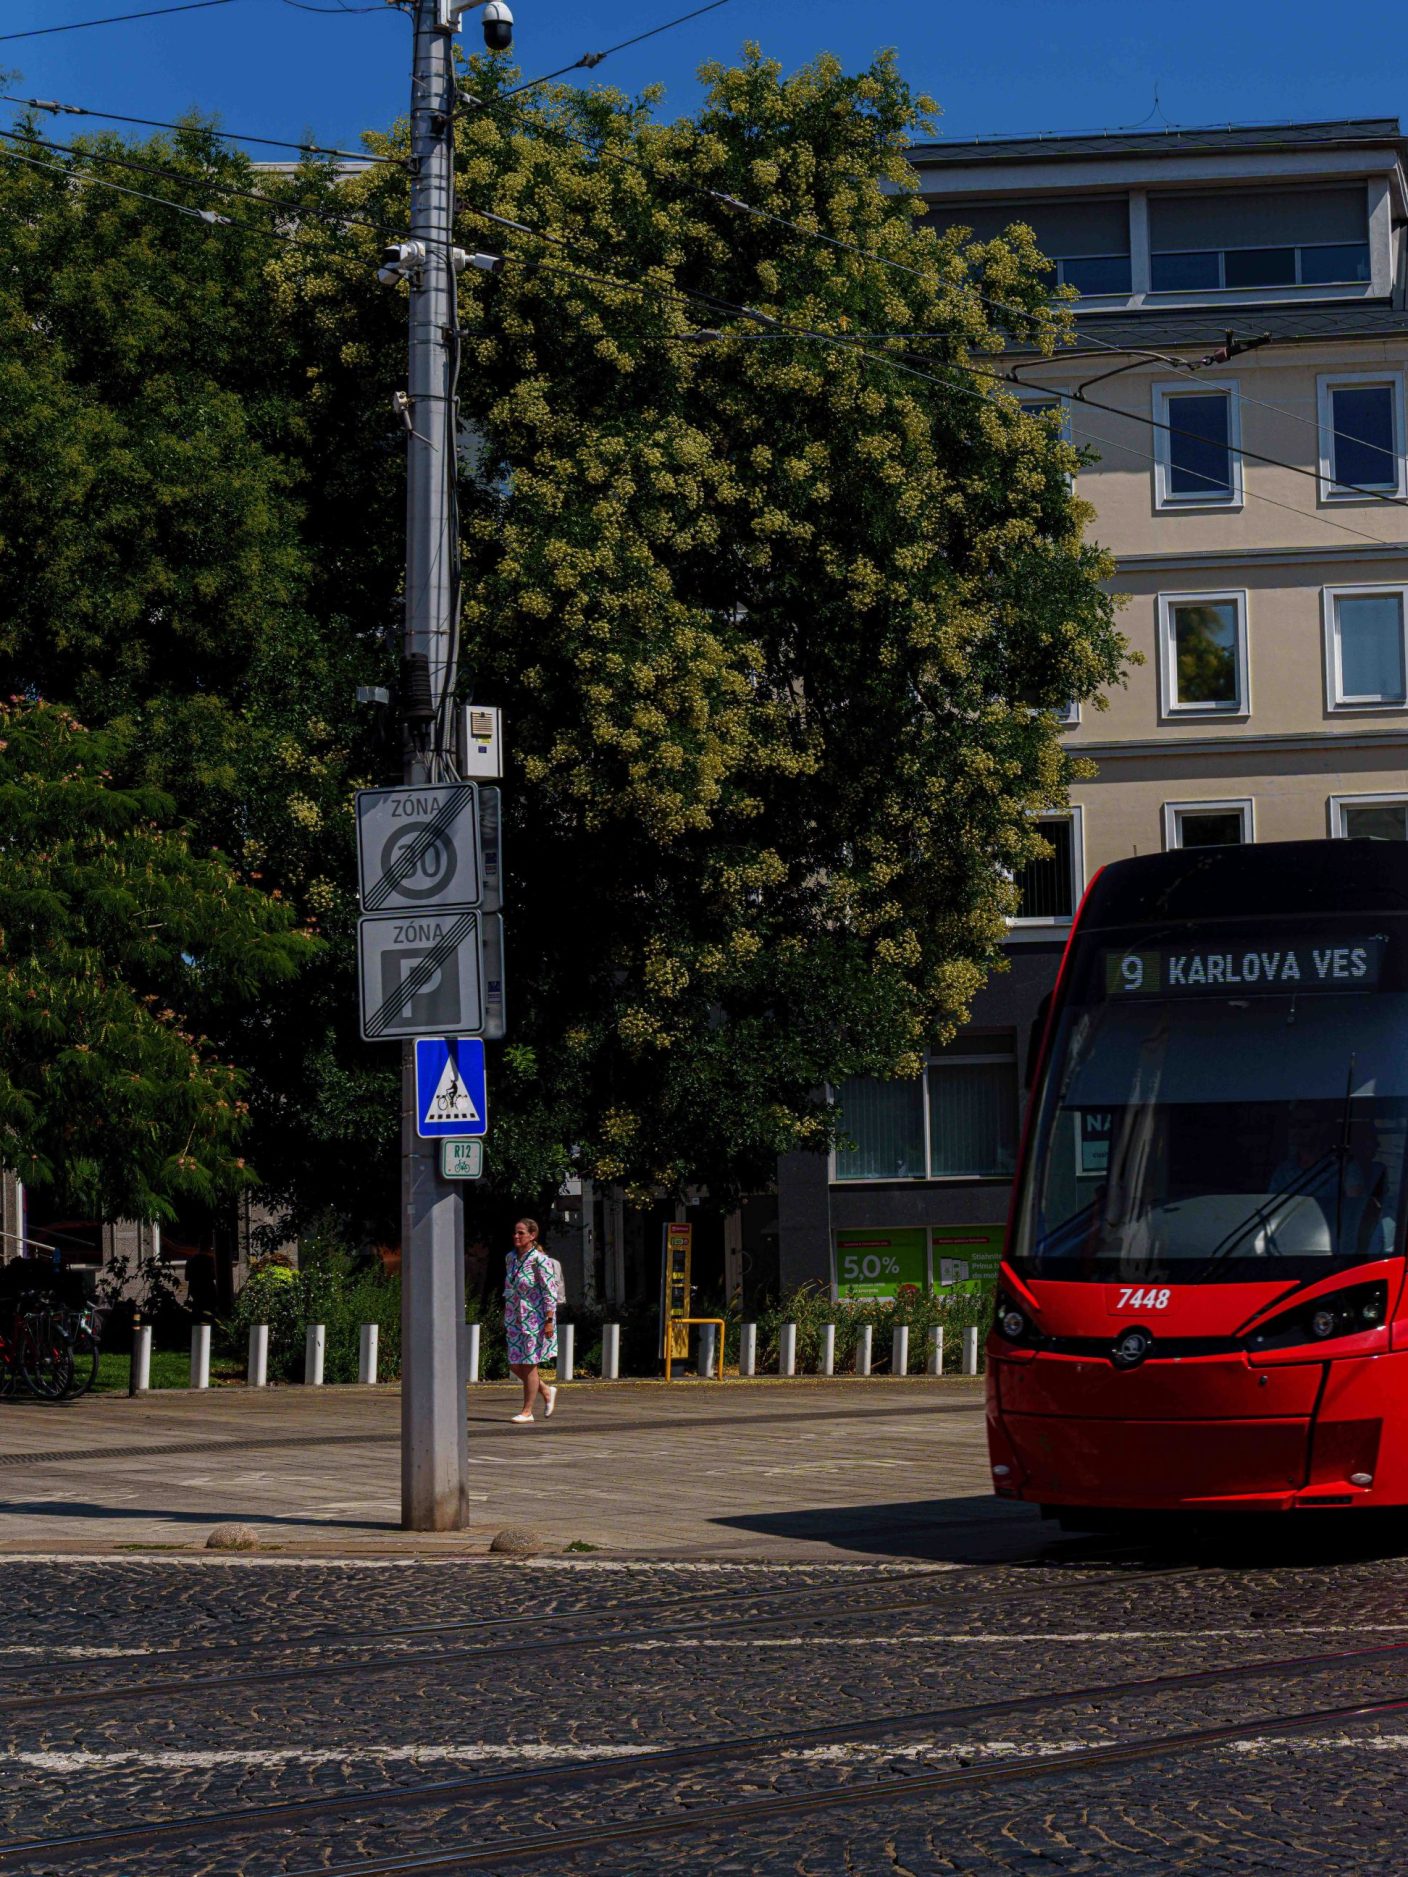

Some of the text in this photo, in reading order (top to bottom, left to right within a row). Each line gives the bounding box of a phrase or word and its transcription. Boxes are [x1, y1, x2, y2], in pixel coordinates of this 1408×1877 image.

[391, 794, 442, 818] ZÓNA
[398, 843, 442, 880] 30
[393, 922, 446, 944] ZÓNA
[1121, 948, 1368, 990] 9 KARLOVA VES
[455, 1144, 471, 1158] R12
[844, 1254, 900, 1281] 5,0%
[1116, 1288, 1172, 1310] 7448
